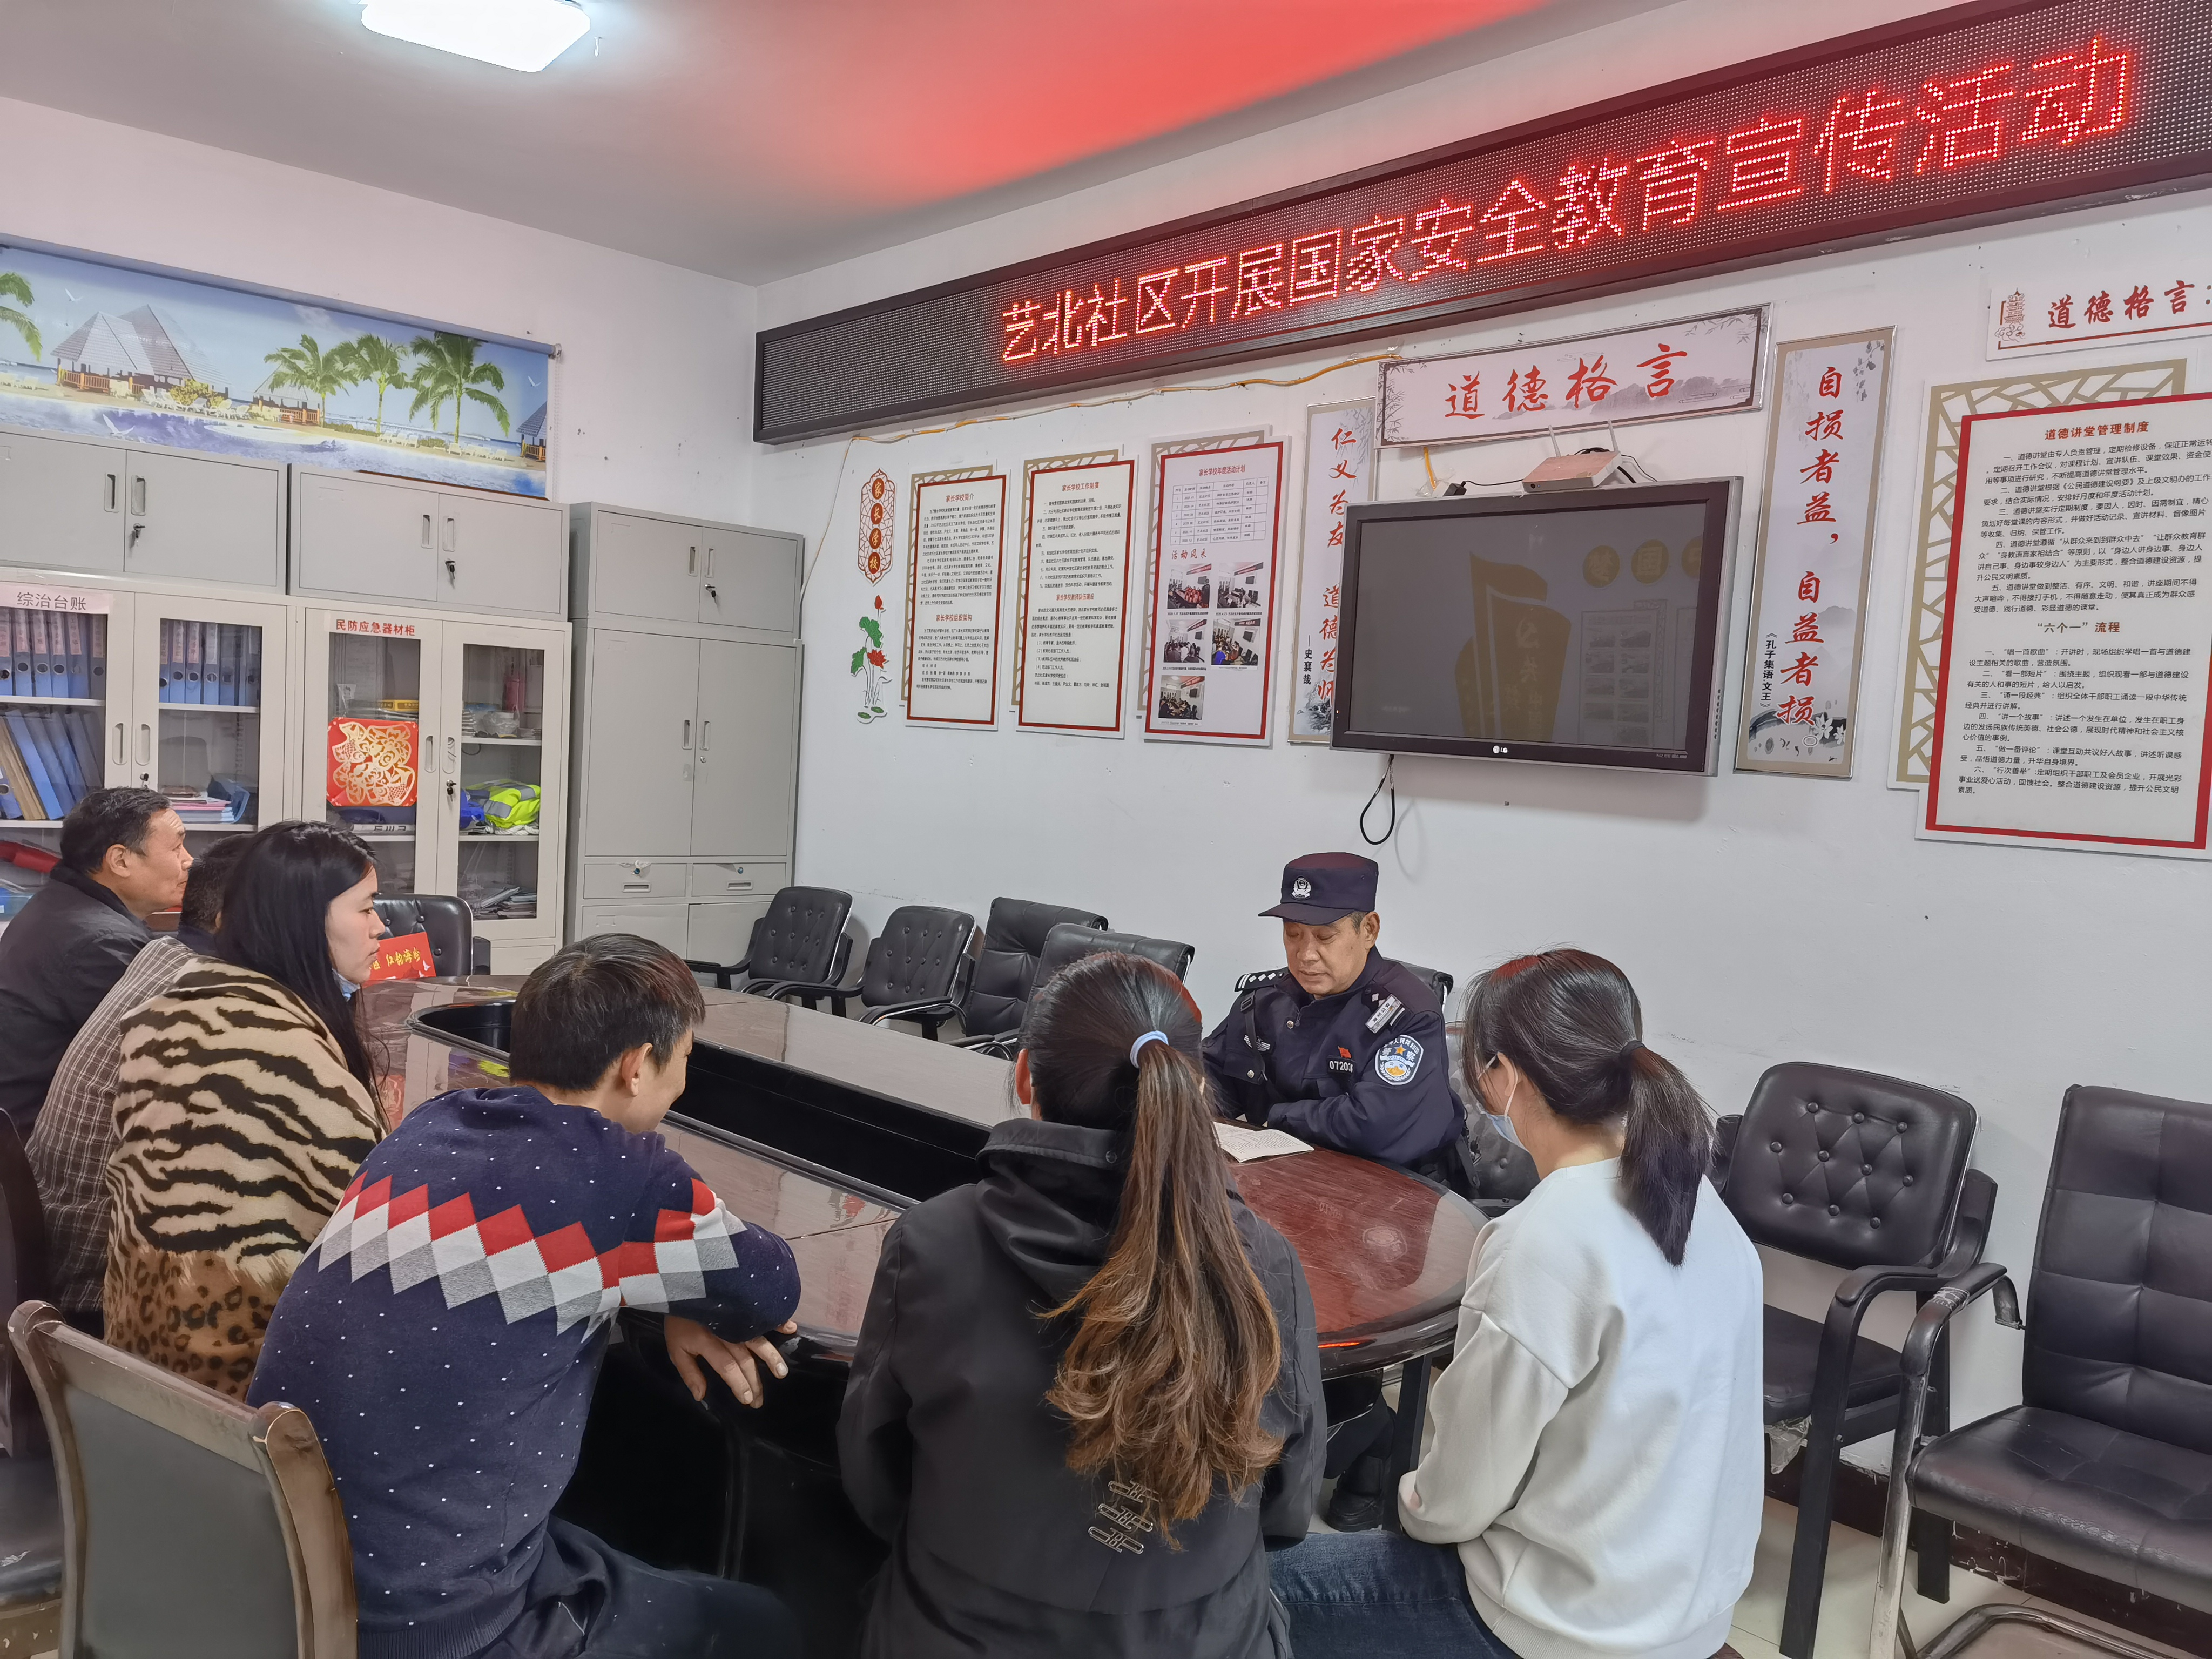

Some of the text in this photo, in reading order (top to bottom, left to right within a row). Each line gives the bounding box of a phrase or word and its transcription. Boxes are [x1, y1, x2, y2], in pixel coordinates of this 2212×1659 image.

[1002, 38, 2128, 361] 艺北社区开展国家安全教育宣传活动
[1445, 343, 1688, 420] 道德格言
[2045, 421, 2149, 440] 道德讲堂管理制度
[1199, 465, 1245, 476] 家长学校年度活动计划
[1062, 482, 1100, 492] 家长学校工作制度
[1329, 428, 1357, 548] 仁义为友
[946, 493, 974, 502] 家长学校简介
[869, 481, 882, 570] 家长学校
[1980, 527, 2065, 538] 等收集、归纳、保管工作。
[1171, 548, 1207, 560] 活动风采
[1976, 572, 2031, 581] 升公民文明素质。
[17, 591, 87, 611] 综治台账
[936, 614, 972, 622] 家长学校组织架构
[336, 618, 415, 637] 民防应急器材柜
[1965, 702, 2021, 710] 经典并进行讲解。
[1962, 733, 2010, 742] 心价值的事例。
[1957, 786, 1975, 794] 素质。
